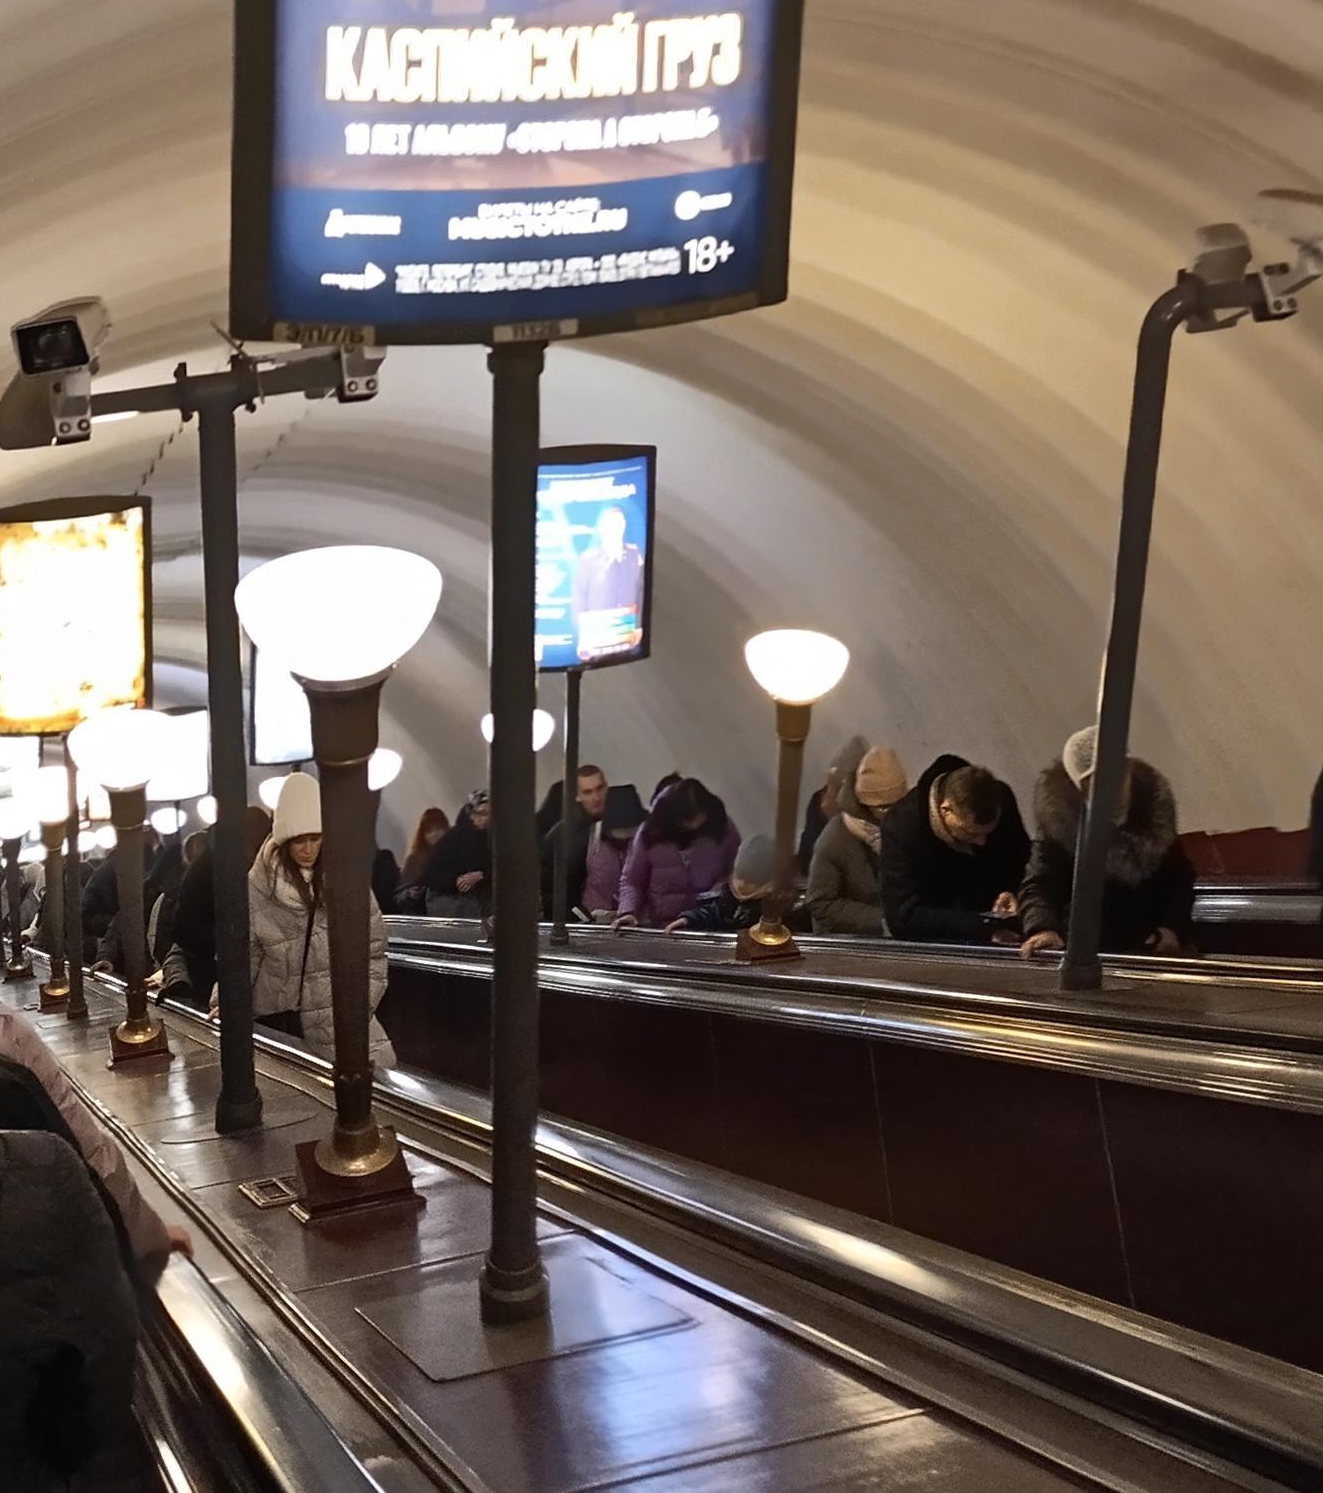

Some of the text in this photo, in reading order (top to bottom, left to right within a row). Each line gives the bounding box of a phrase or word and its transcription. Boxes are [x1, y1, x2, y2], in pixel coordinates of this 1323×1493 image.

[325, 12, 742, 103] КАСПИЙСКИЙ ГРУЗ
[684, 236, 735, 274] 18+
